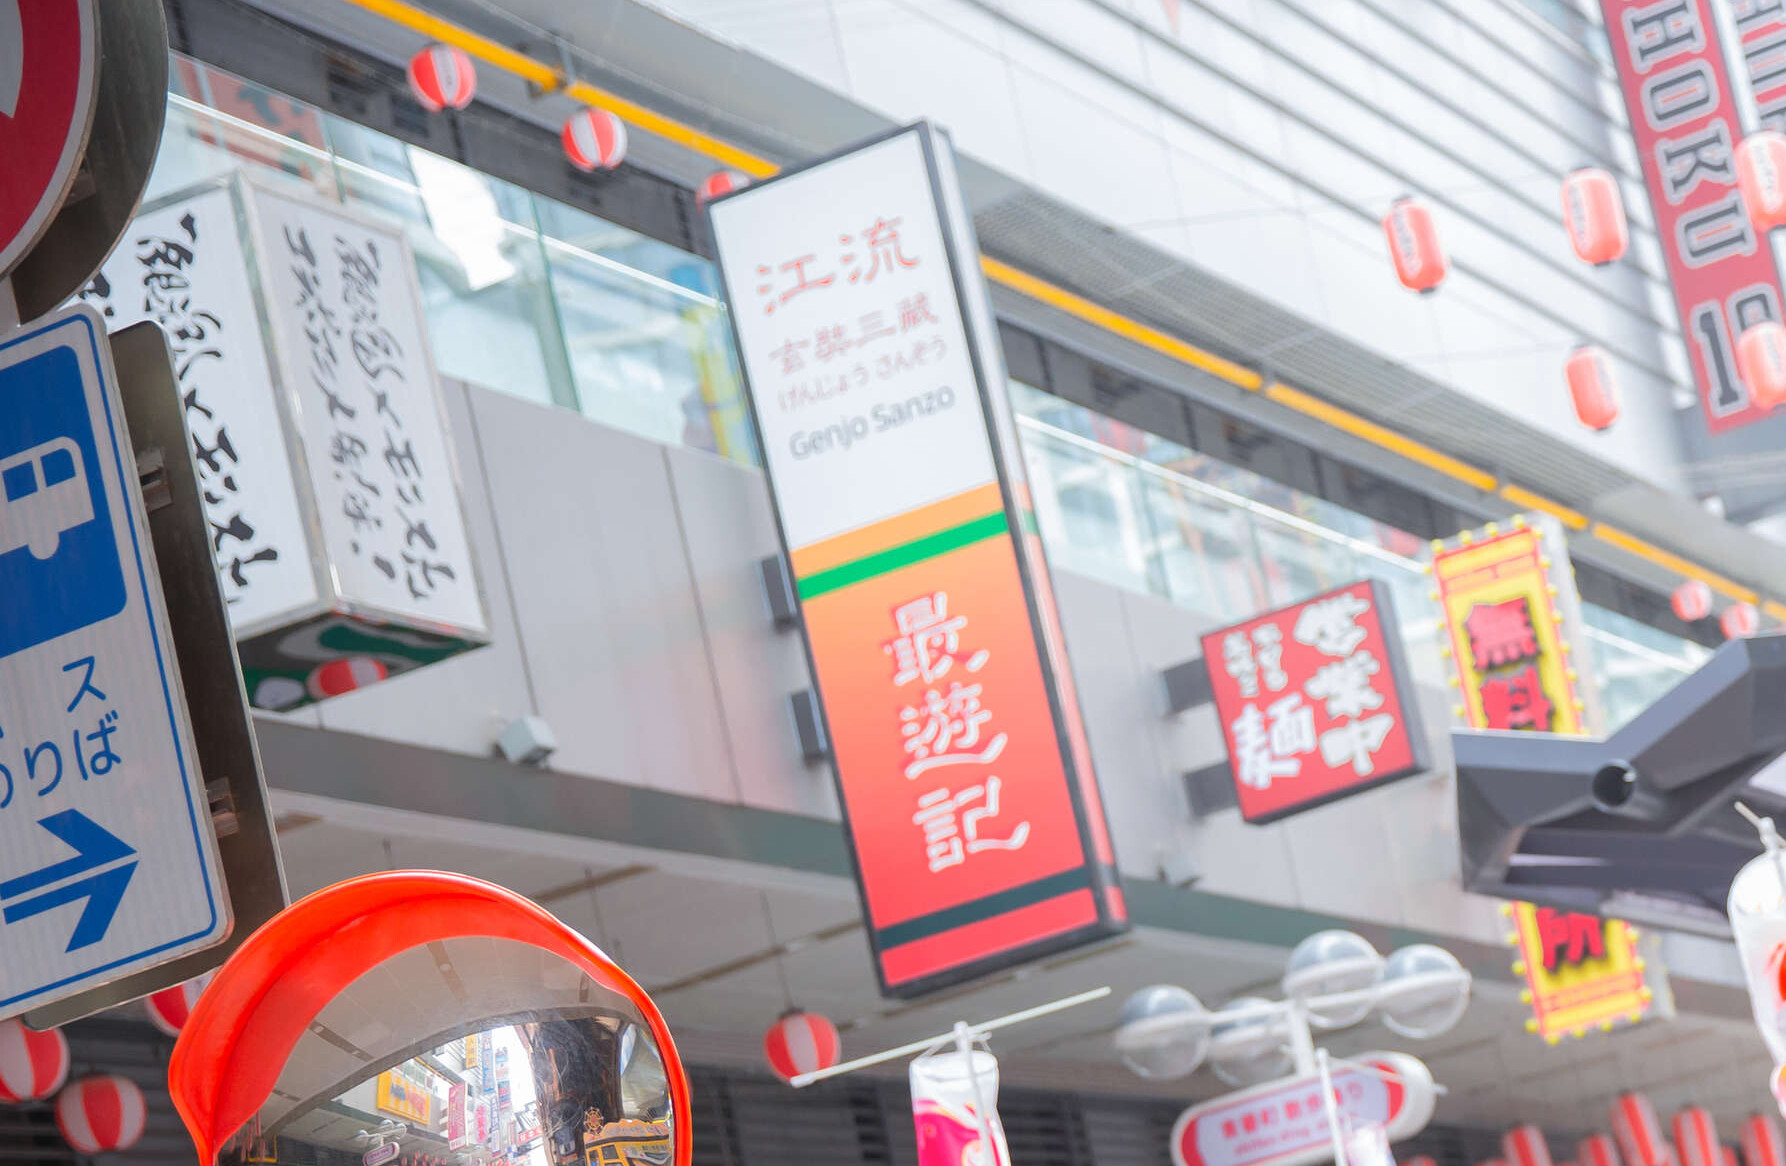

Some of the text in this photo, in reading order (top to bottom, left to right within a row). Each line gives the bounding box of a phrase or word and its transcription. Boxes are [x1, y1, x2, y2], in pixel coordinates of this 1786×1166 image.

[757, 216, 923, 315] 江流
[788, 385, 957, 461] Genjo Sanzo
[884, 590, 1030, 874] 最遊記
